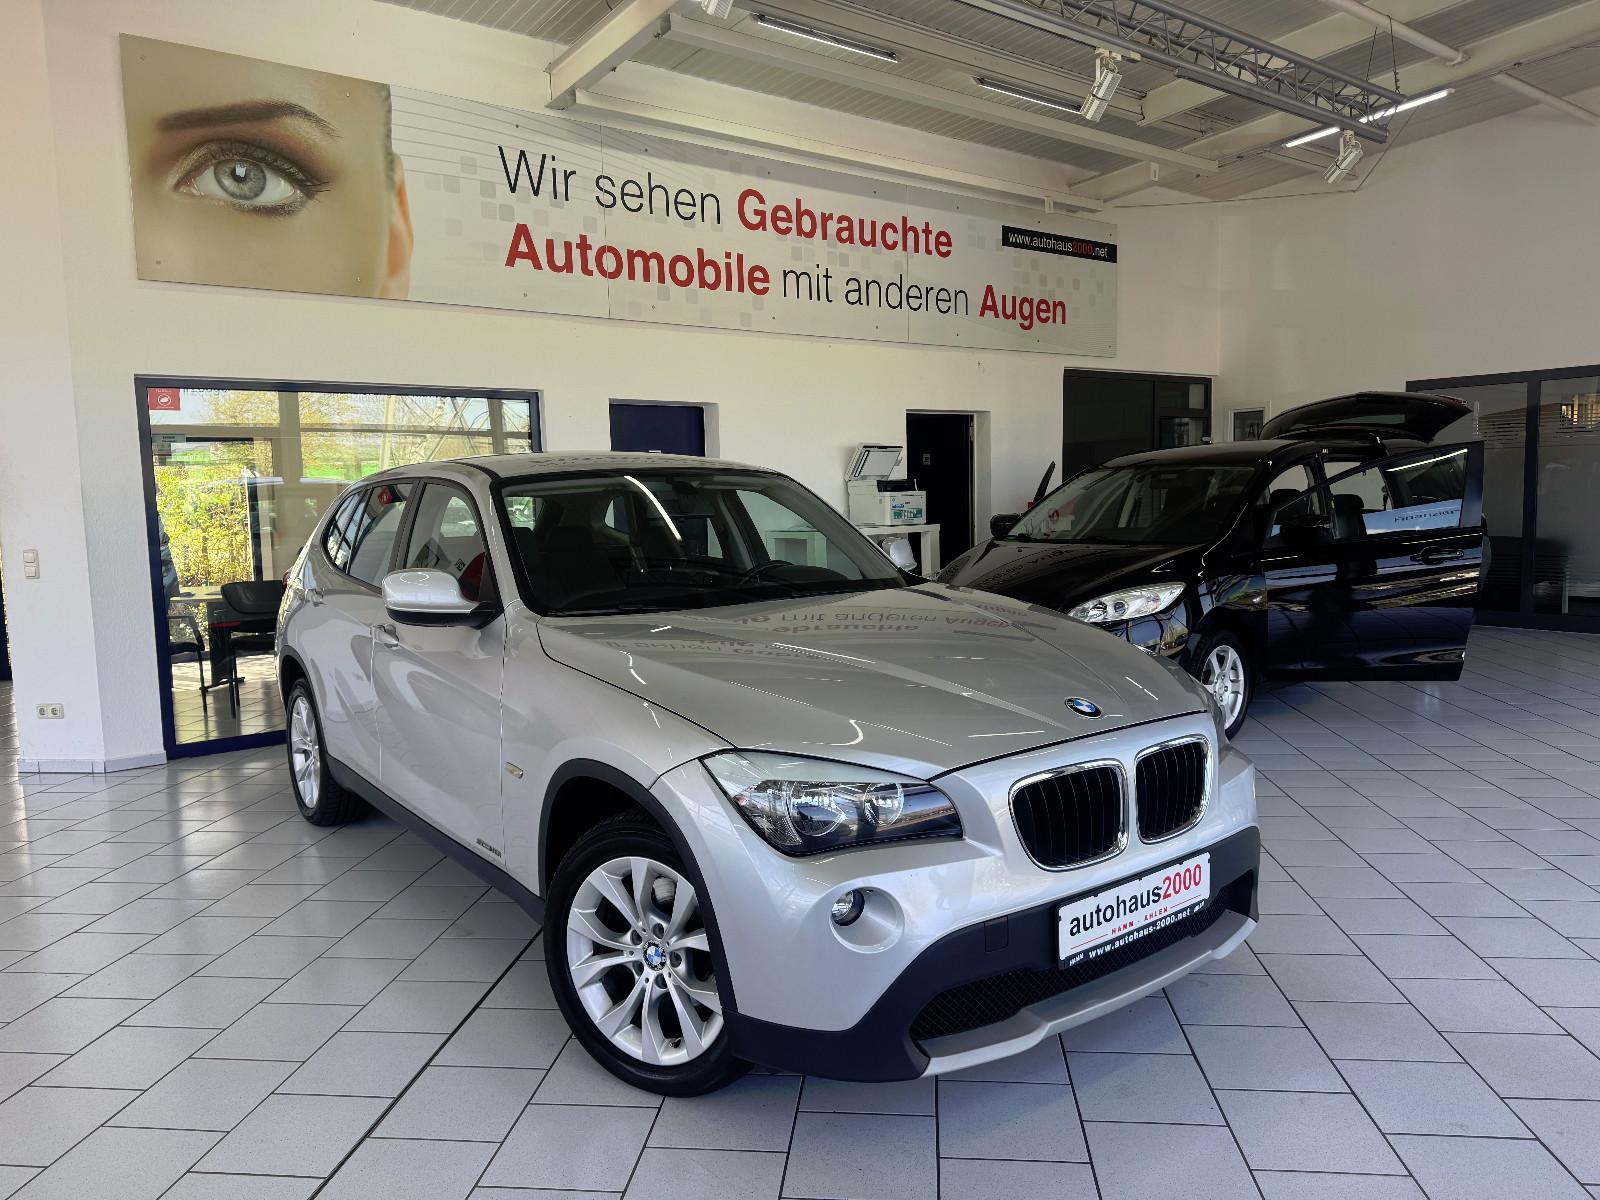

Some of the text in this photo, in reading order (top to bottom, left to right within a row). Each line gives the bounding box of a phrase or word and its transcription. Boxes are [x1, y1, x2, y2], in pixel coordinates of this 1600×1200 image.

[497, 146, 954, 259] Wir sehen Gebrauchte
[504, 223, 1067, 331] Automobile mit anderen Augen
[1008, 232, 1109, 258] www.autohaus2000.net
[1069, 863, 1202, 937] autohaus2000
[1088, 909, 1191, 959] www.autohaus-2000.net
